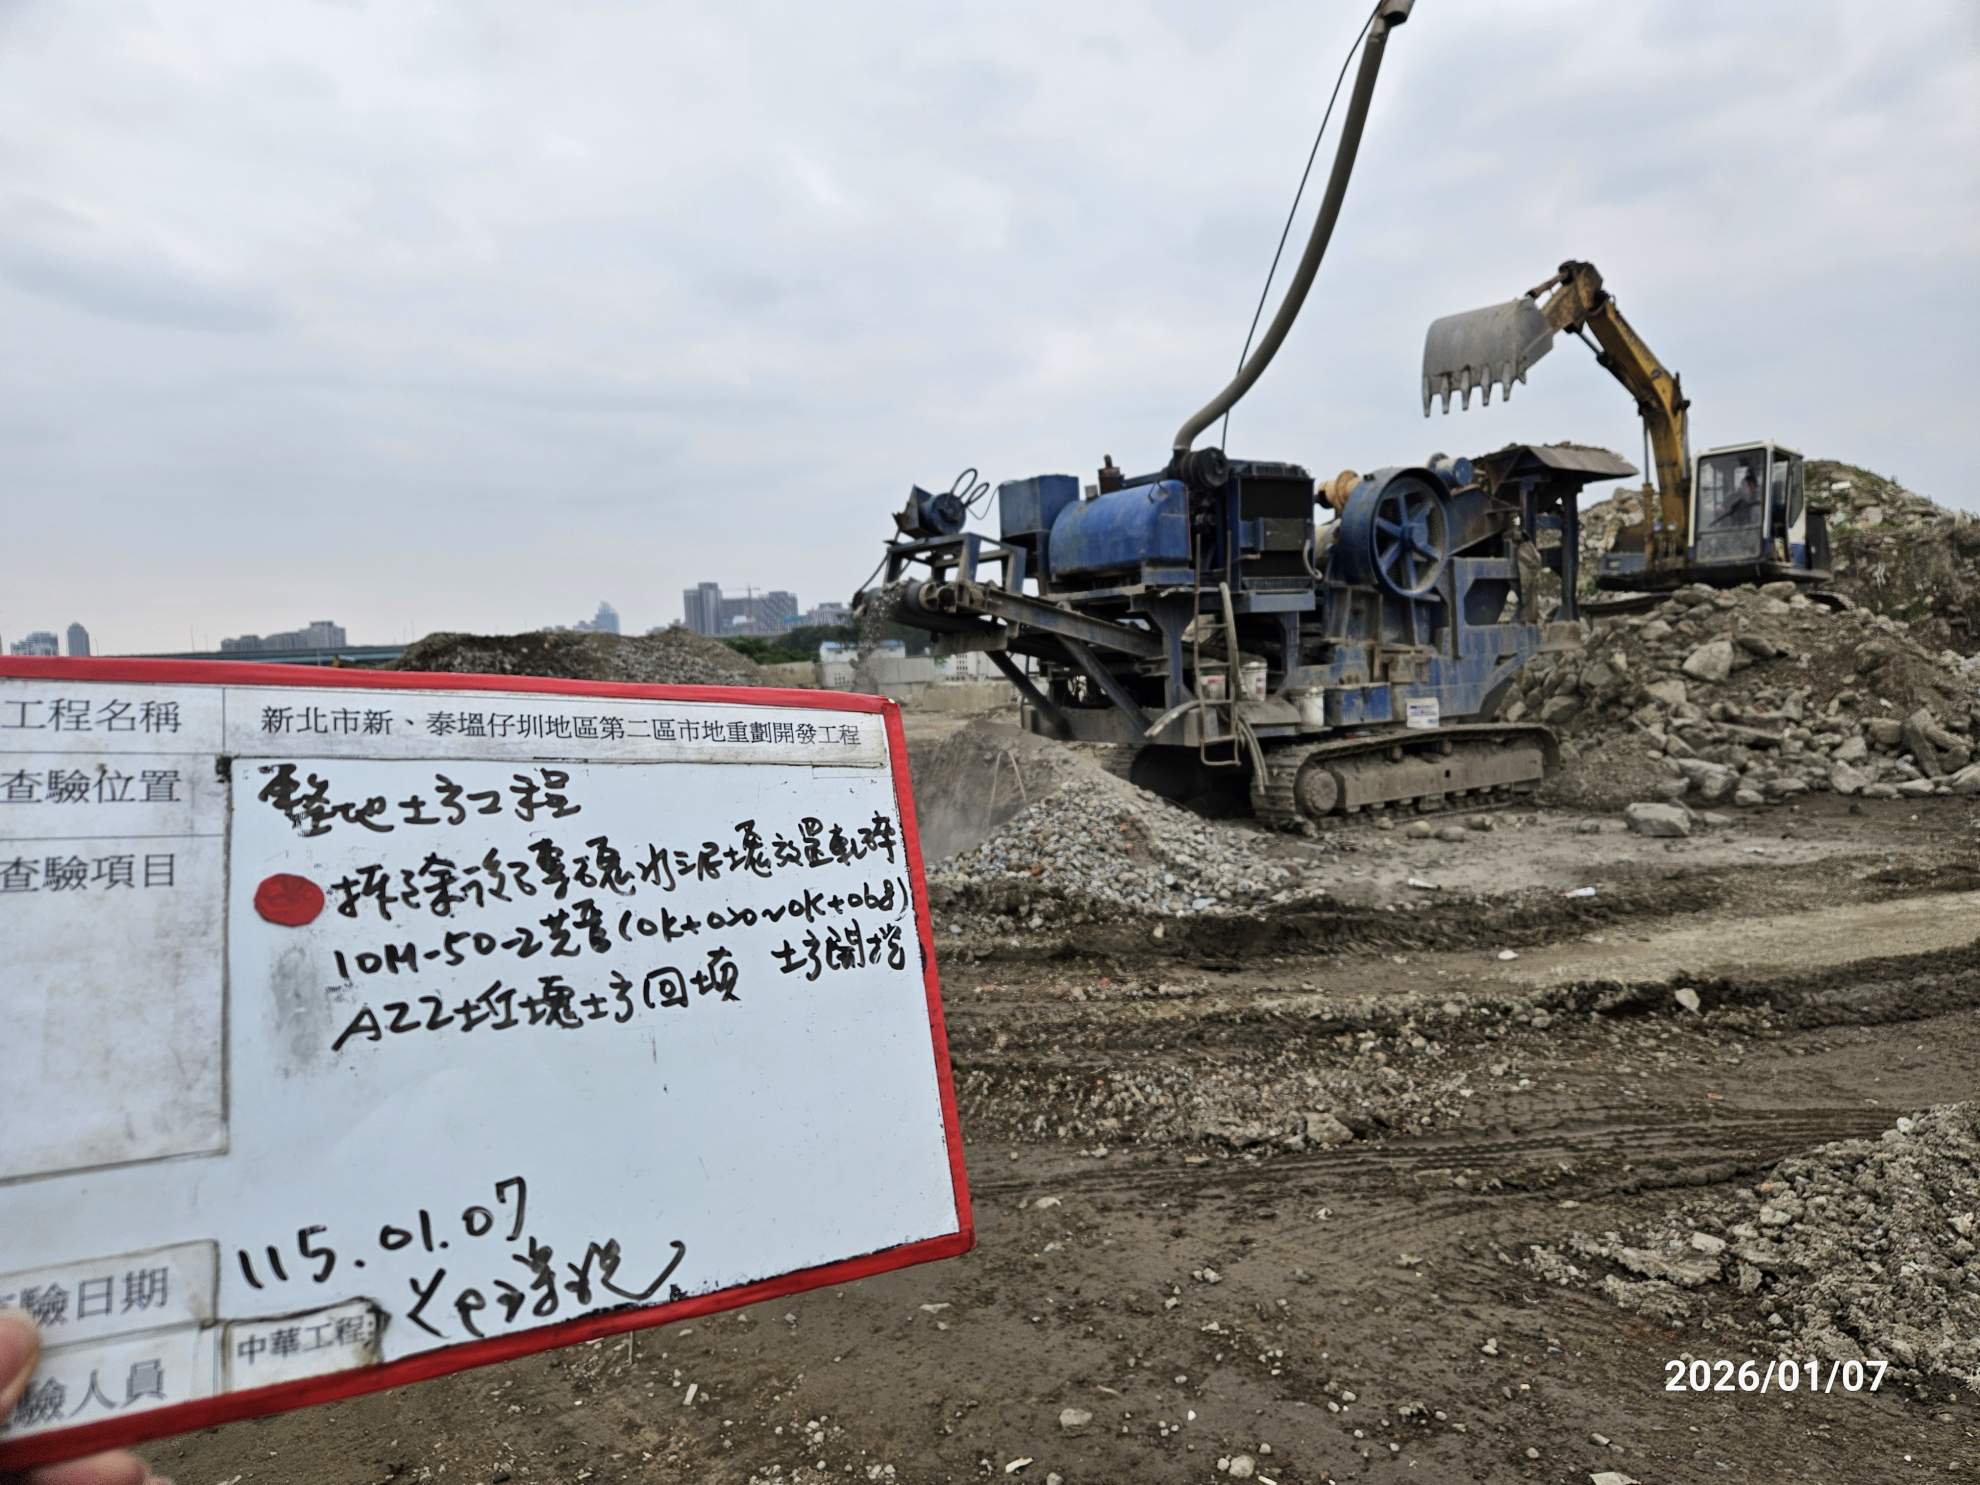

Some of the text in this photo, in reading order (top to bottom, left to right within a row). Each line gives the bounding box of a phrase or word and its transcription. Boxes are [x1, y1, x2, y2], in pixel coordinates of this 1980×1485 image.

[1, 698, 182, 733] 工程名稱
[261, 706, 862, 746] 新北市新、泰塭仔圳地區第二區市地重劃開發工程
[0, 768, 182, 804] 查驗位置
[0, 854, 175, 893] 查驗項目
[238, 1176, 526, 1289] 115.01.07
[0, 1266, 169, 1327] 驗日期
